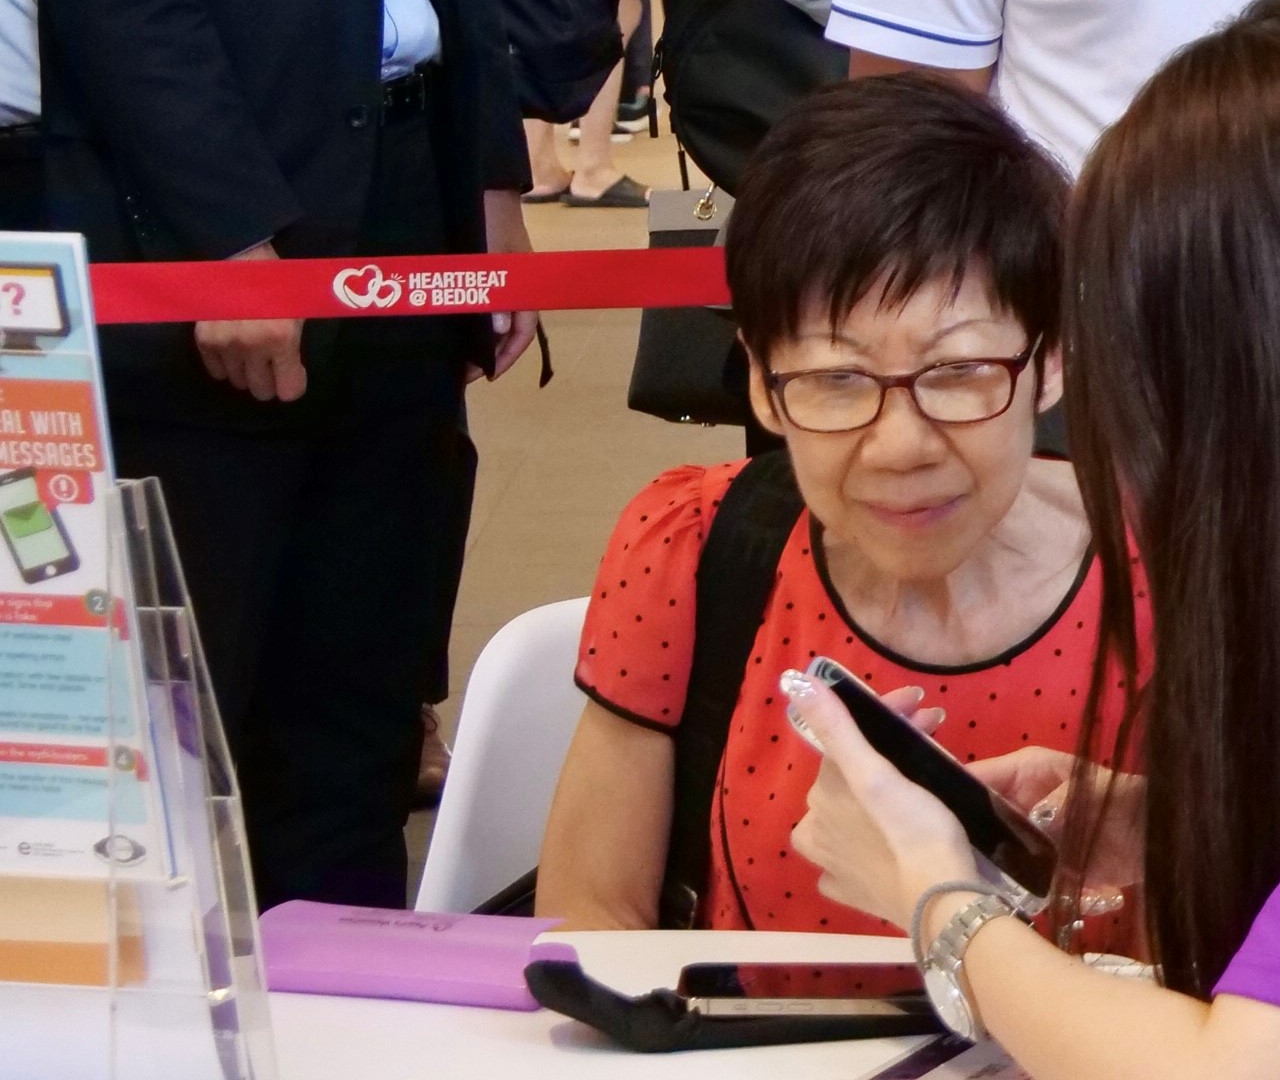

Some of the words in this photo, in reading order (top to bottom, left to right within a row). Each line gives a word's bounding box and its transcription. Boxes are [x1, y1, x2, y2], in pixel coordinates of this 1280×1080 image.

[408, 270, 508, 290] HEARTBEAT
[408, 290, 427, 307] @
[431, 287, 491, 306] BEDOK
[0, 408, 26, 434] AL
[30, 409, 84, 437] WITH
[92, 595, 105, 612] 2
